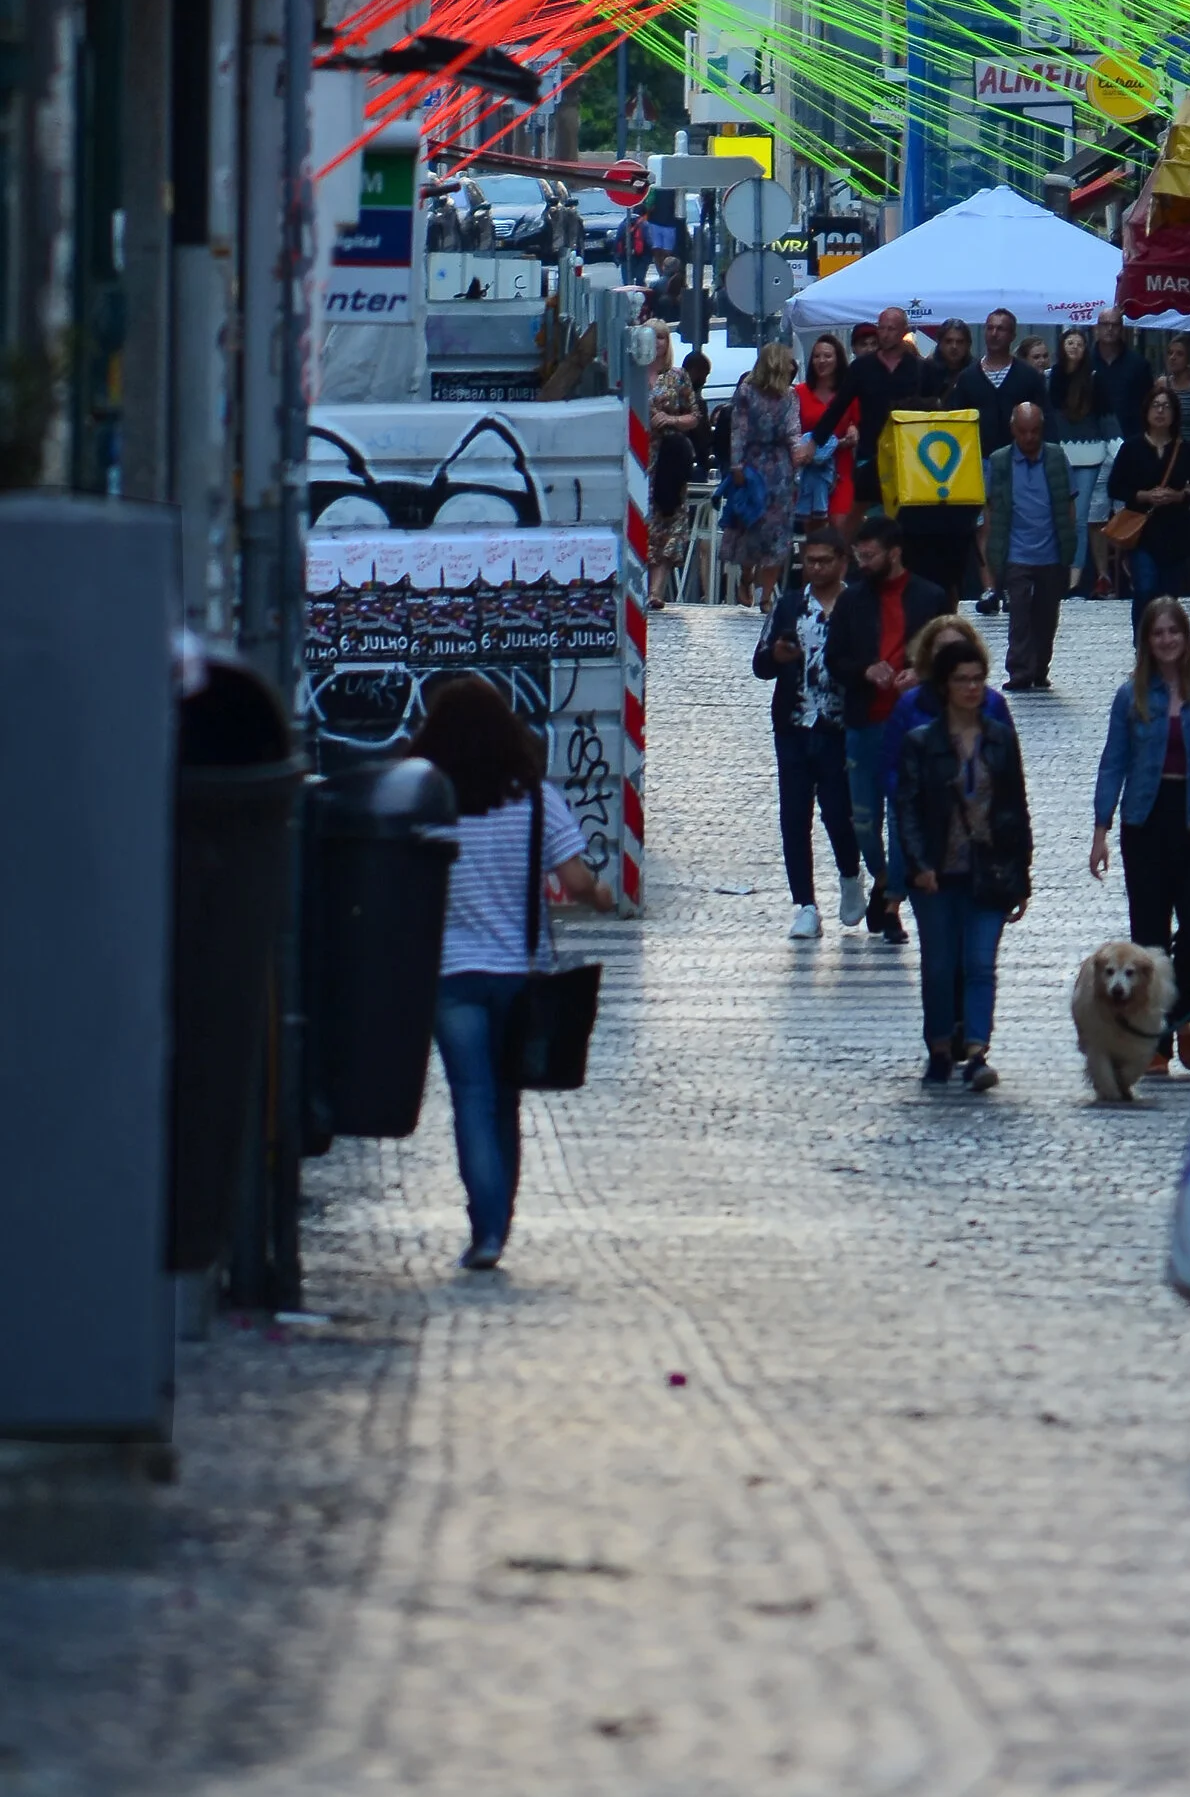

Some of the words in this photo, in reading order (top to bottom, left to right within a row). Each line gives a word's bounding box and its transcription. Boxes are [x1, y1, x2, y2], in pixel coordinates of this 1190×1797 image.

[326, 288, 408, 313] nter
[358, 635, 408, 651] JULHO
[500, 632, 548, 649] JULHO
[567, 631, 616, 647] JULHO
[428, 640, 477, 655] JULHO
